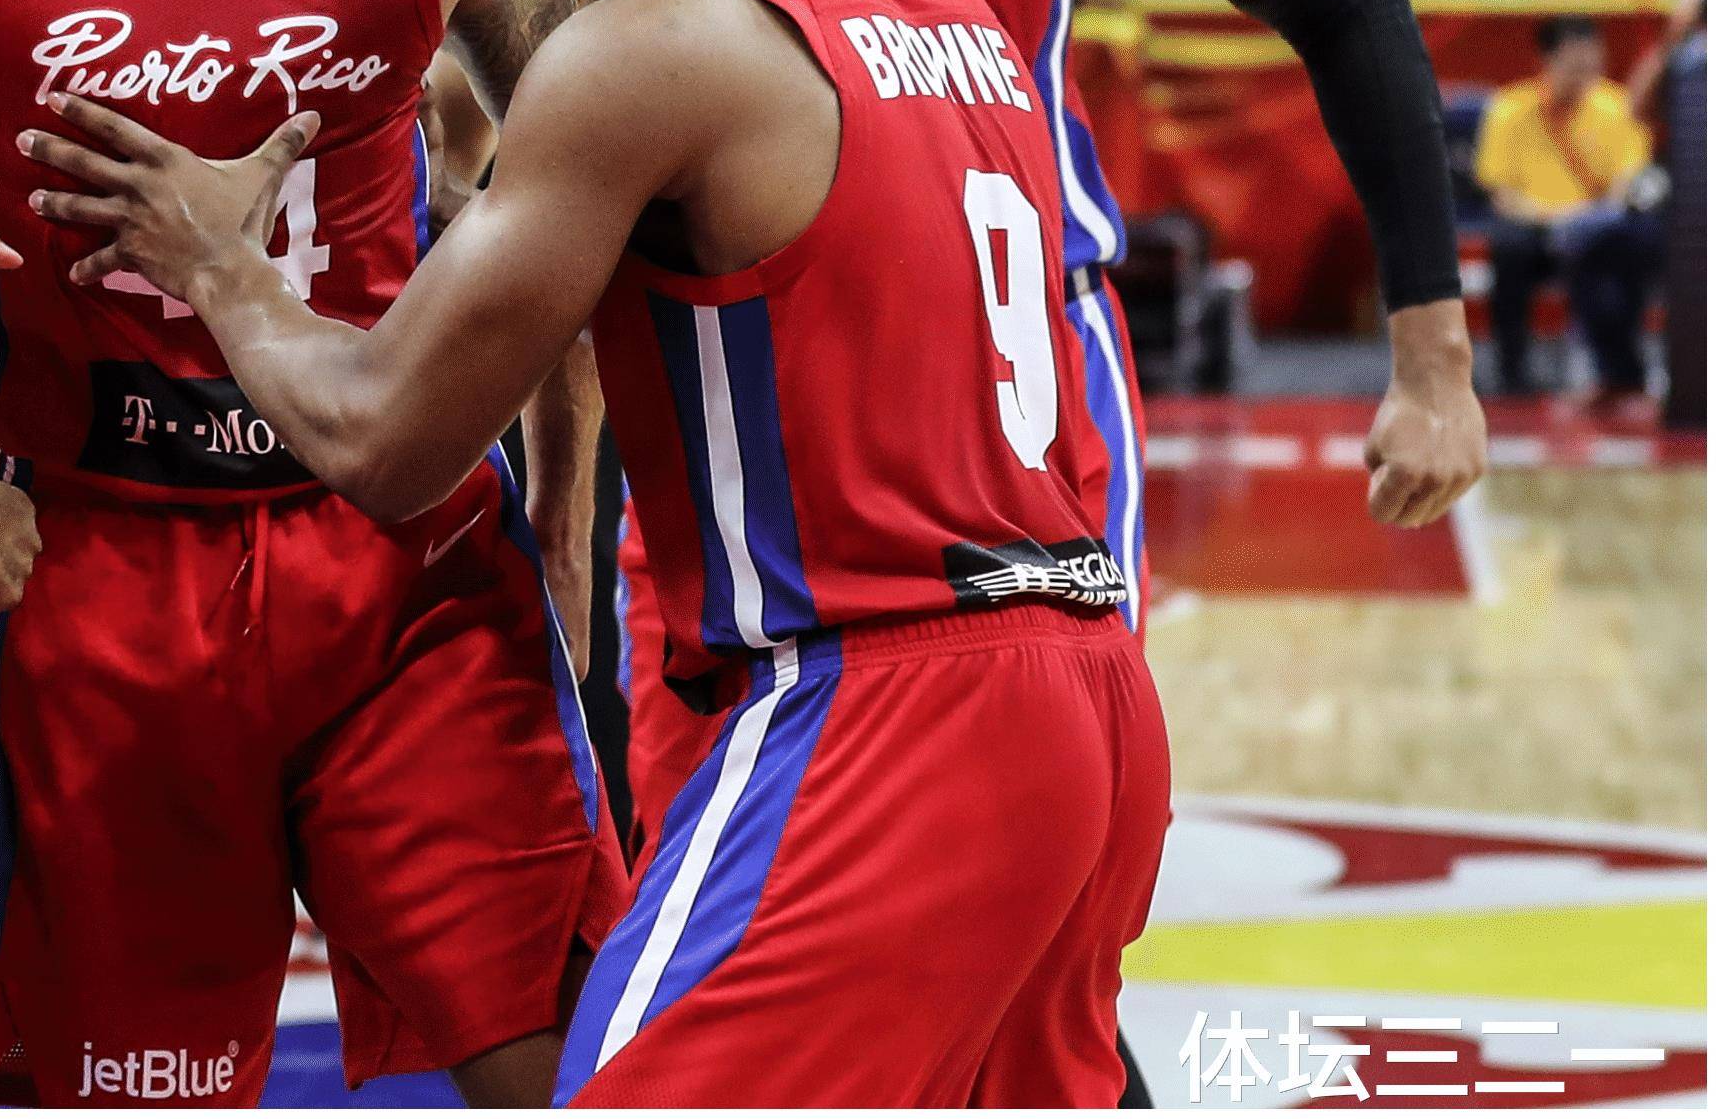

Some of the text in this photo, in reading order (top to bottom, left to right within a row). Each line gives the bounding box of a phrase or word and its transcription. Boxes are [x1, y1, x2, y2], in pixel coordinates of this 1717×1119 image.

[32, 9, 390, 115] Puerto Rico
[840, 14, 1032, 112] BROWNE
[963, 168, 1060, 472] 9
[78, 1041, 234, 1099] jetBlue
